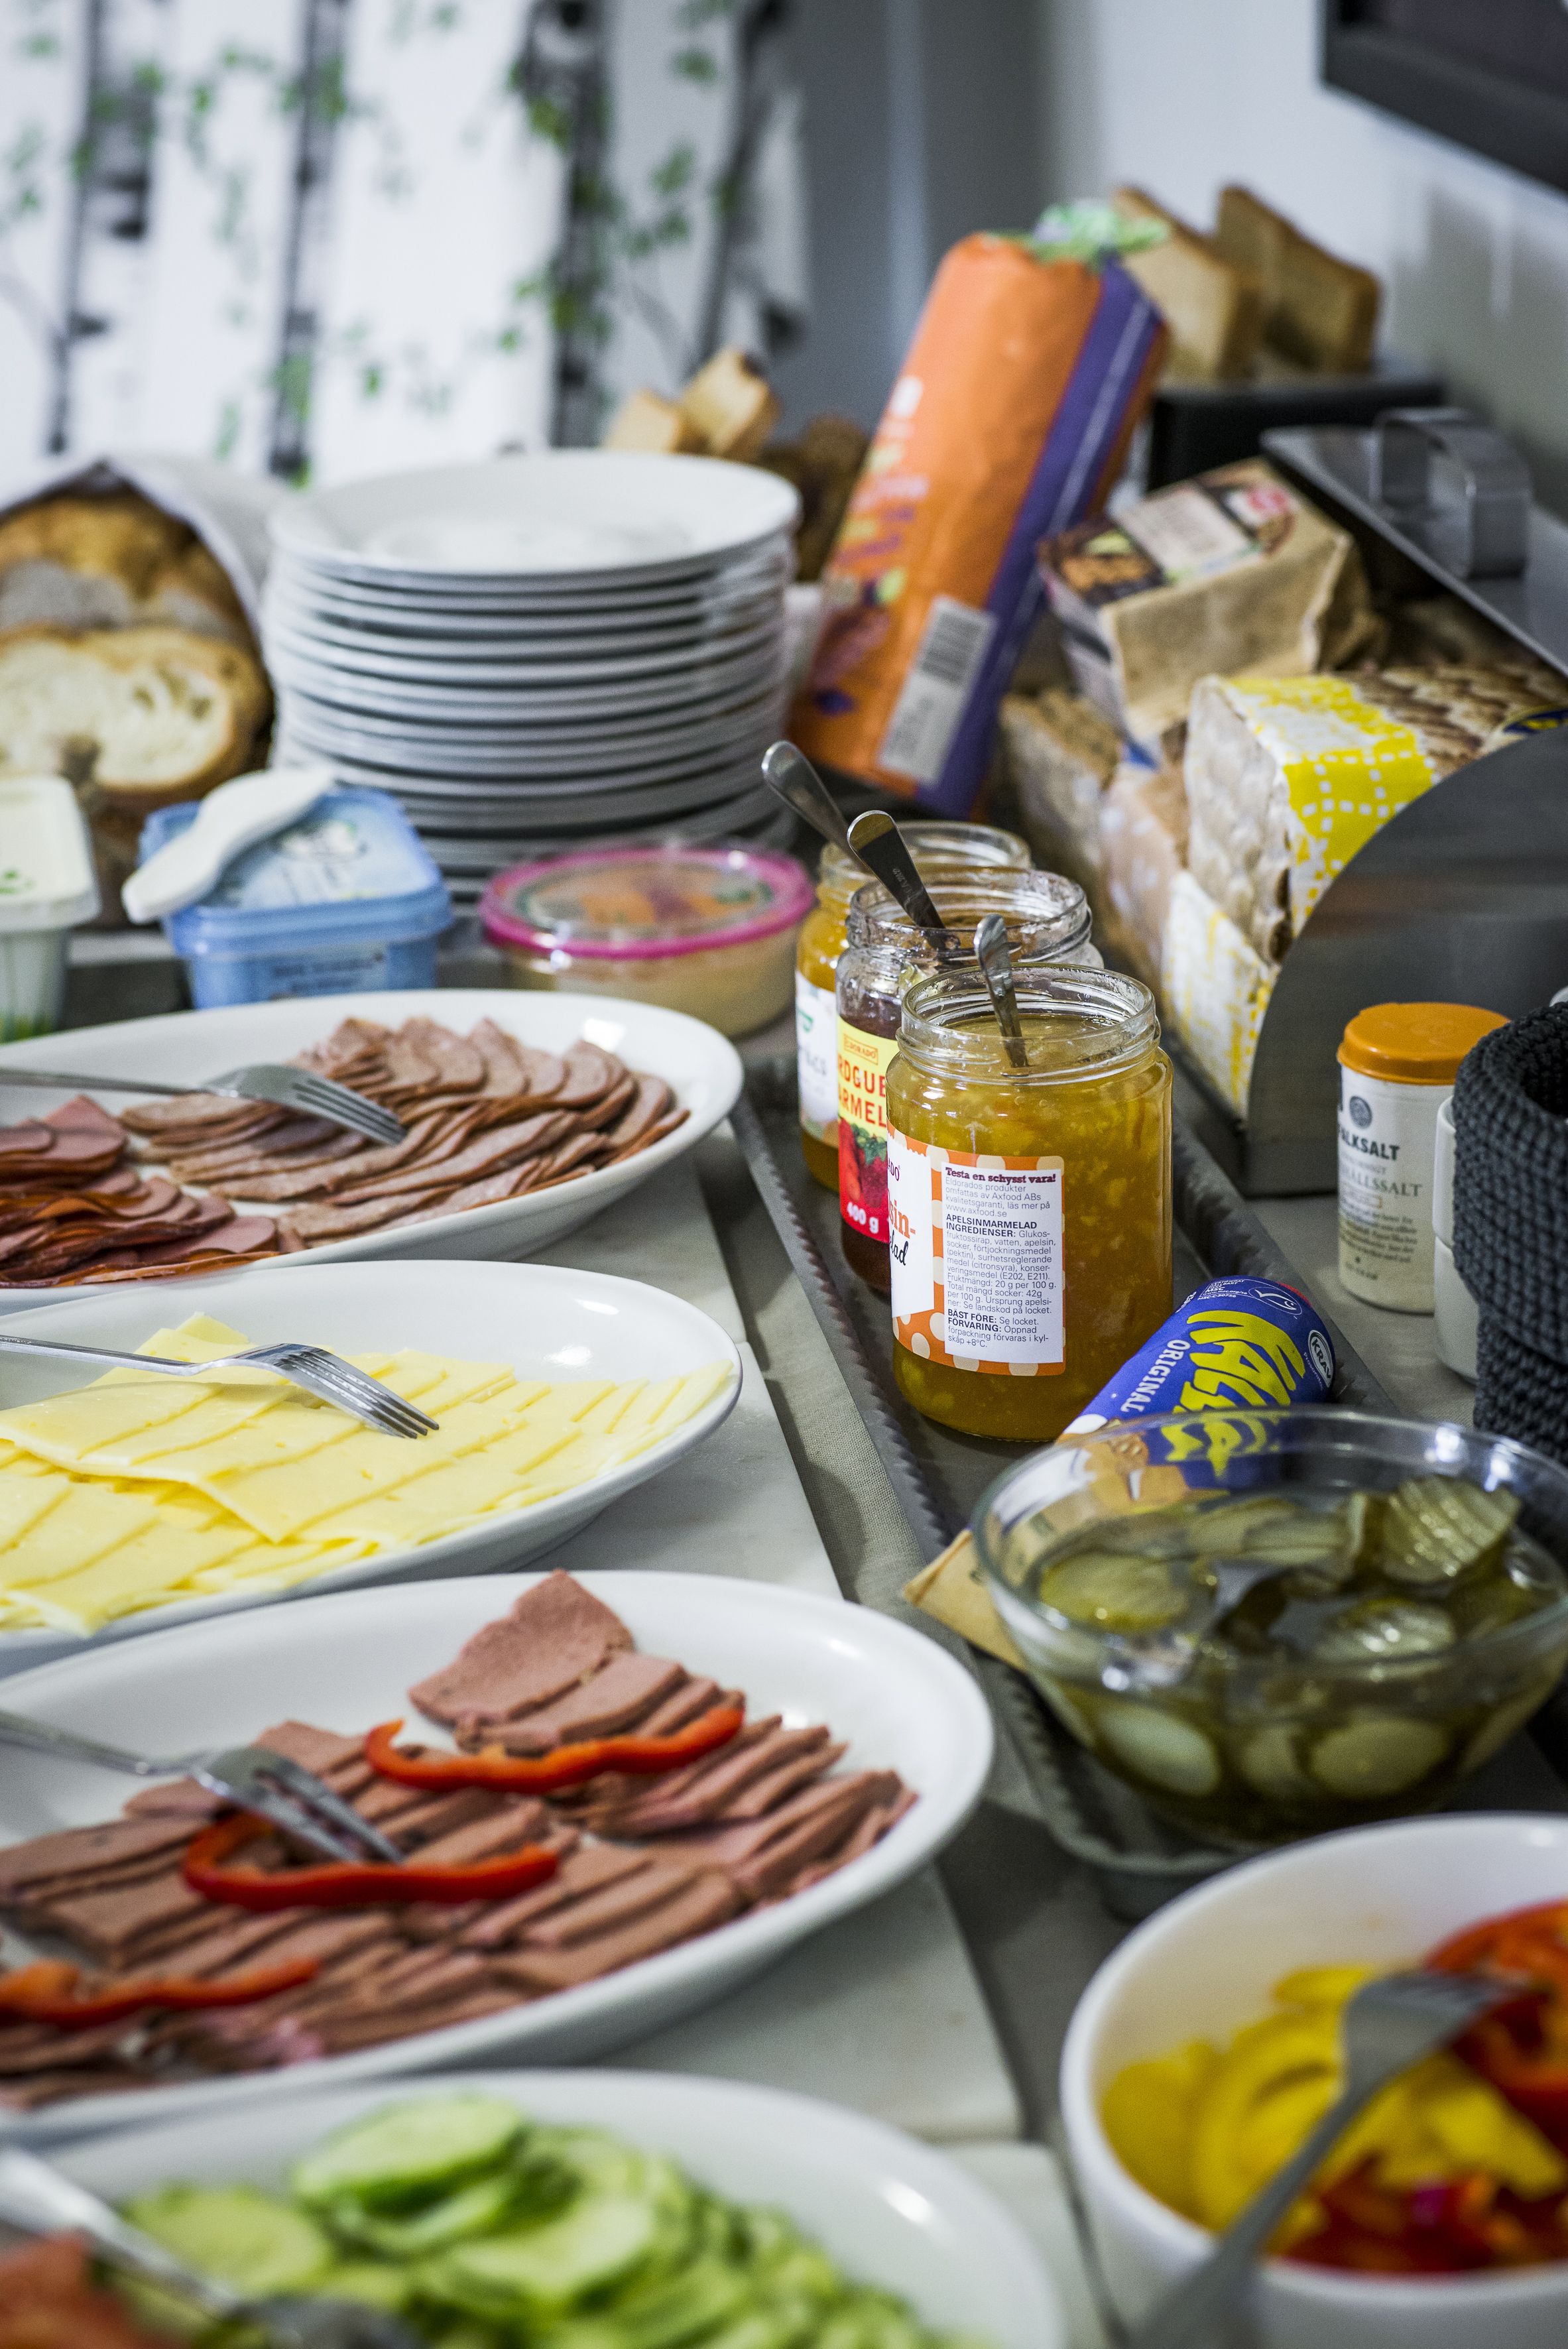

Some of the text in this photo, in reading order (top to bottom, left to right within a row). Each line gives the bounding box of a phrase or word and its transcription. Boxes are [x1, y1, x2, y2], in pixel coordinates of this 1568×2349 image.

[945, 1167, 970, 1179] Testa
[988, 1174, 1026, 1185] schysst
[1028, 1174, 1056, 1183] vara!
[945, 1177, 1026, 1193] Eldorados produkter
[945, 1187, 979, 1198] omfattas
[945, 1195, 1005, 1210] kvalitetsgaranti,
[1040, 1201, 1051, 1211] på
[945, 1204, 1007, 1218] www.axfood.se
[946, 1213, 1038, 1229] APELSINMARMELAD
[946, 1222, 1016, 1238] INGREDIENSER:
[946, 1230, 1056, 1247] fruktossirap, vatten, apelsin,
[947, 1240, 1052, 1256] socker, förtjockningsmedel
[947, 1248, 1052, 1265] (pektin), surhetsreglerande
[947, 1256, 969, 1267] medel
[971, 1260, 1018, 1273] (citronsyra),
[947, 1266, 1050, 1281] veringsmedel (E202, E211).
[947, 1272, 993, 1288] Fruktmängd:
[947, 1280, 1042, 1298] Total mängd socker: 42g
[961, 1292, 974, 1301] 100
[975, 1295, 983, 1304] g.
[985, 1296, 1023, 1307] Ursprung
[1025, 1297, 1052, 1306] apelsi-
[947, 1308, 969, 1320] BÄST
[971, 1313, 996, 1324] FÖRE:
[975, 1303, 1010, 1314] landskod
[1012, 1305, 1023, 1315] på
[947, 1317, 1037, 1335] FÖRVARING: Öppnad
[948, 1326, 991, 1341] förpackning
[1034, 1334, 1049, 1344] kyl-
[948, 1335, 965, 1345] skåp
[1311, 1338, 1331, 1379] KRAV
[1120, 1339, 1191, 1414] ORIGINAL
